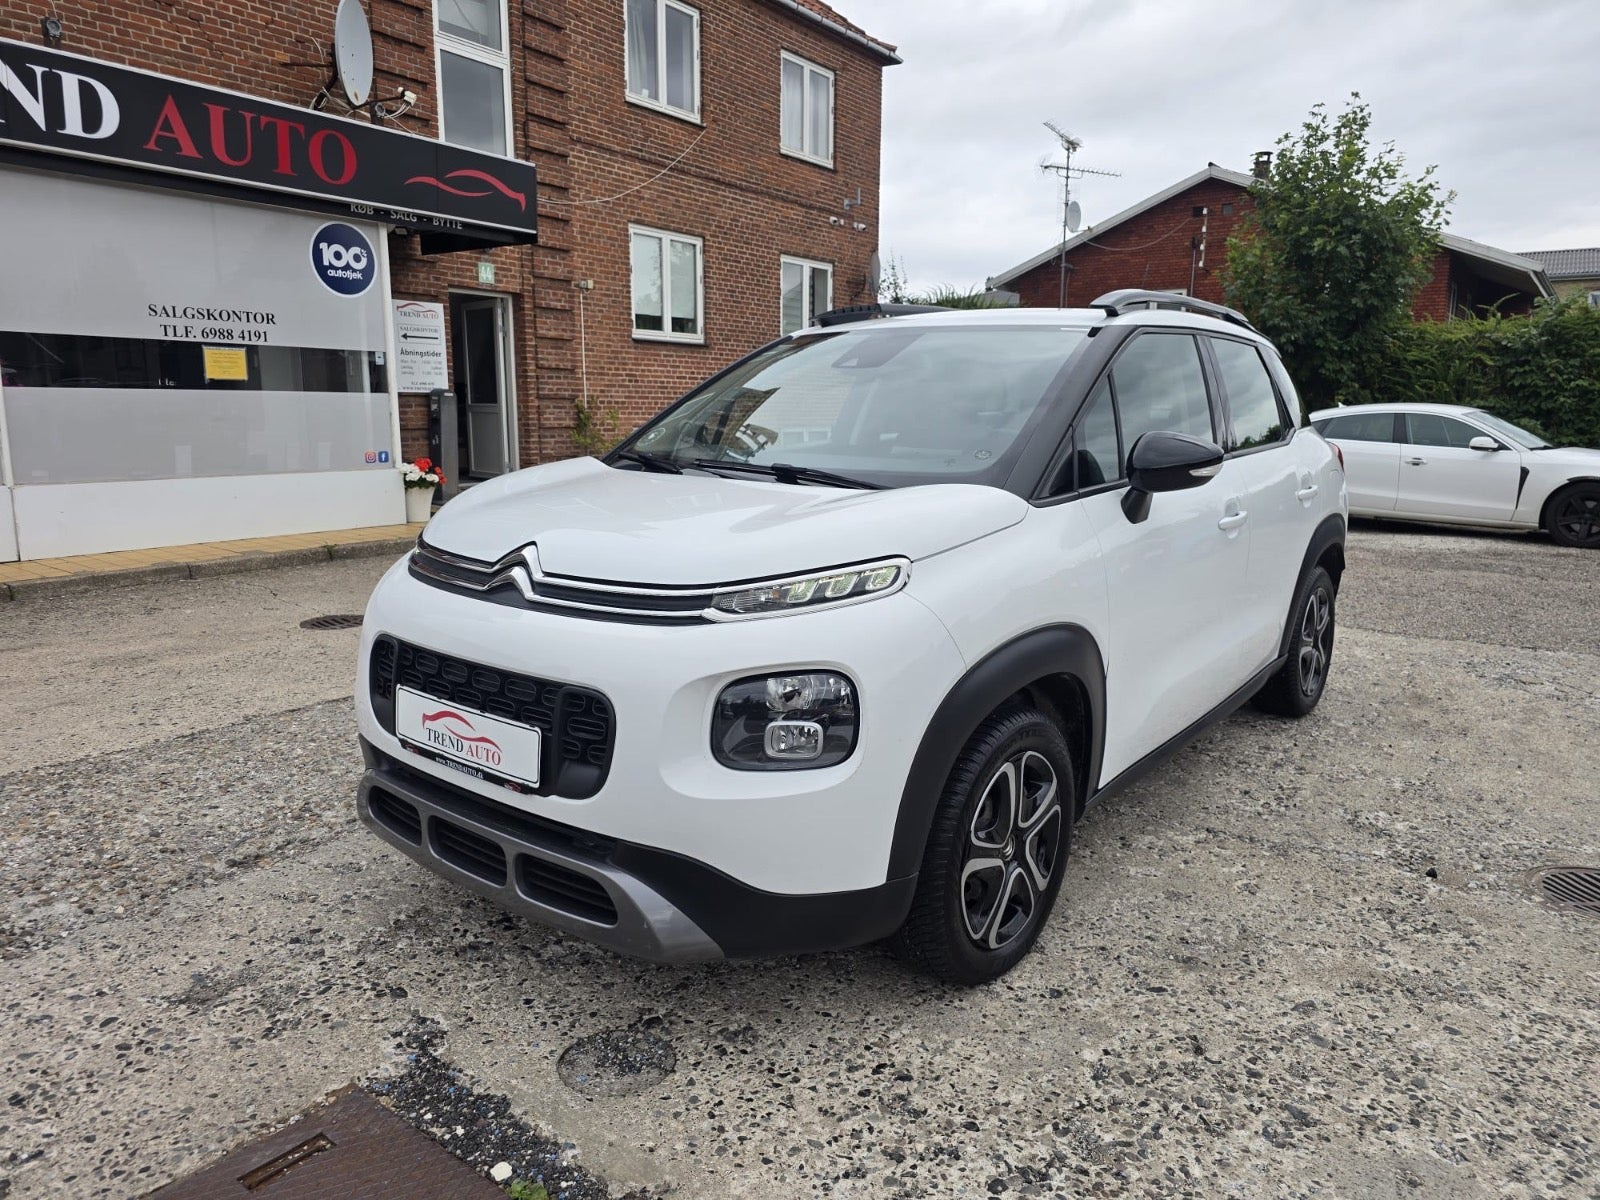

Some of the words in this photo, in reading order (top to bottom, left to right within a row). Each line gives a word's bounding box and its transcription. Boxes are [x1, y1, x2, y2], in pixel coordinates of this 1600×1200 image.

[143, 94, 358, 187] AUTO
[390, 209, 418, 223] SALG
[432, 217, 464, 230] BYTTE
[327, 269, 364, 281] autotjek
[148, 303, 277, 325] SALGSKONTOR
[399, 311, 421, 319] TREND
[160, 324, 197, 339] TLF.
[201, 327, 234, 341] 6988
[238, 329, 268, 343] 4191
[400, 346, 442, 358] Åbningstider
[426, 727, 464, 753] TREND
[466, 743, 501, 766] AUTO
